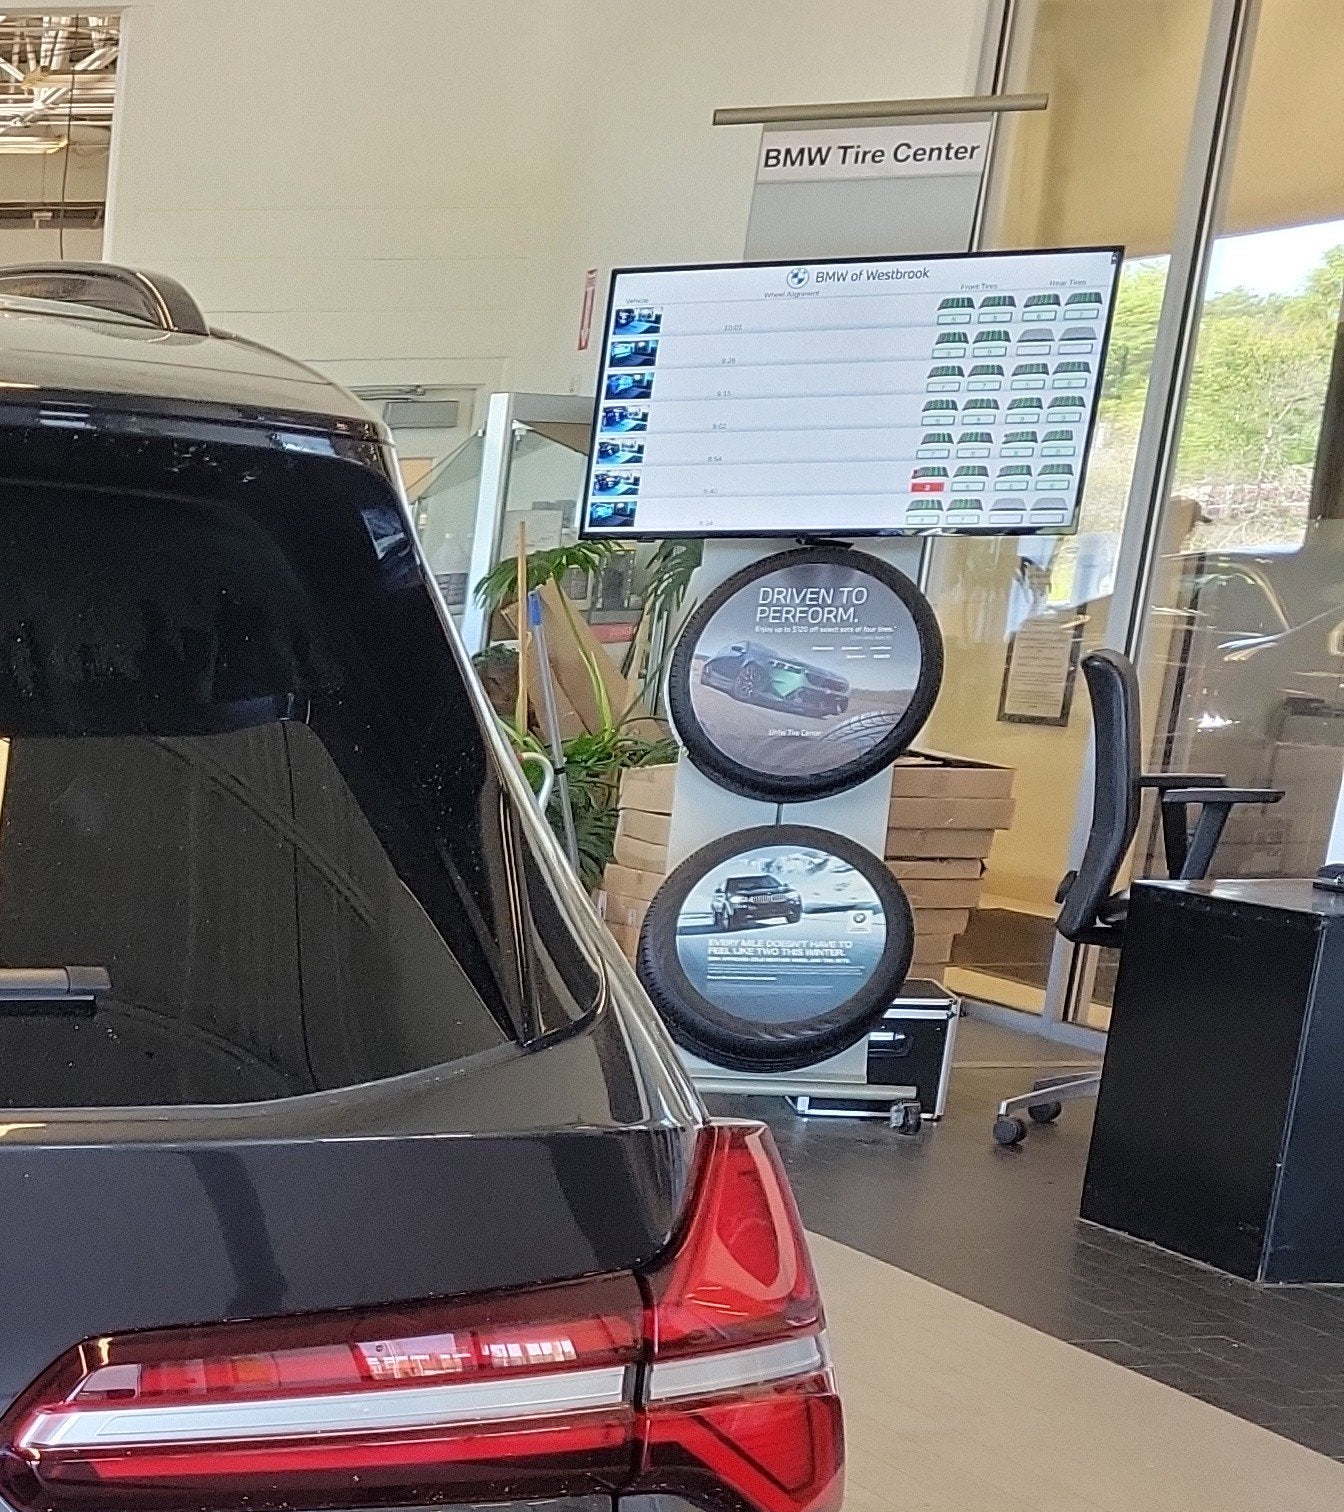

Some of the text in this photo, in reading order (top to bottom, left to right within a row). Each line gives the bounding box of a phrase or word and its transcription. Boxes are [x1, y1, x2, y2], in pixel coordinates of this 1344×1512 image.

[763, 142, 981, 169] BMW Tire Center
[815, 267, 931, 284] BMW of Westbrook
[1068, 279, 1087, 287] Tires
[764, 290, 820, 300] Wheel Alignment
[758, 587, 868, 605] DRIVEN TO
[755, 606, 859, 624] PERFORM.
[755, 626, 774, 634] Enjoy
[708, 938, 853, 949] EVERY MILE DOESN'T HAVE TO
[708, 946, 847, 957] FEEL LIKE TWO THIS WINTER.
